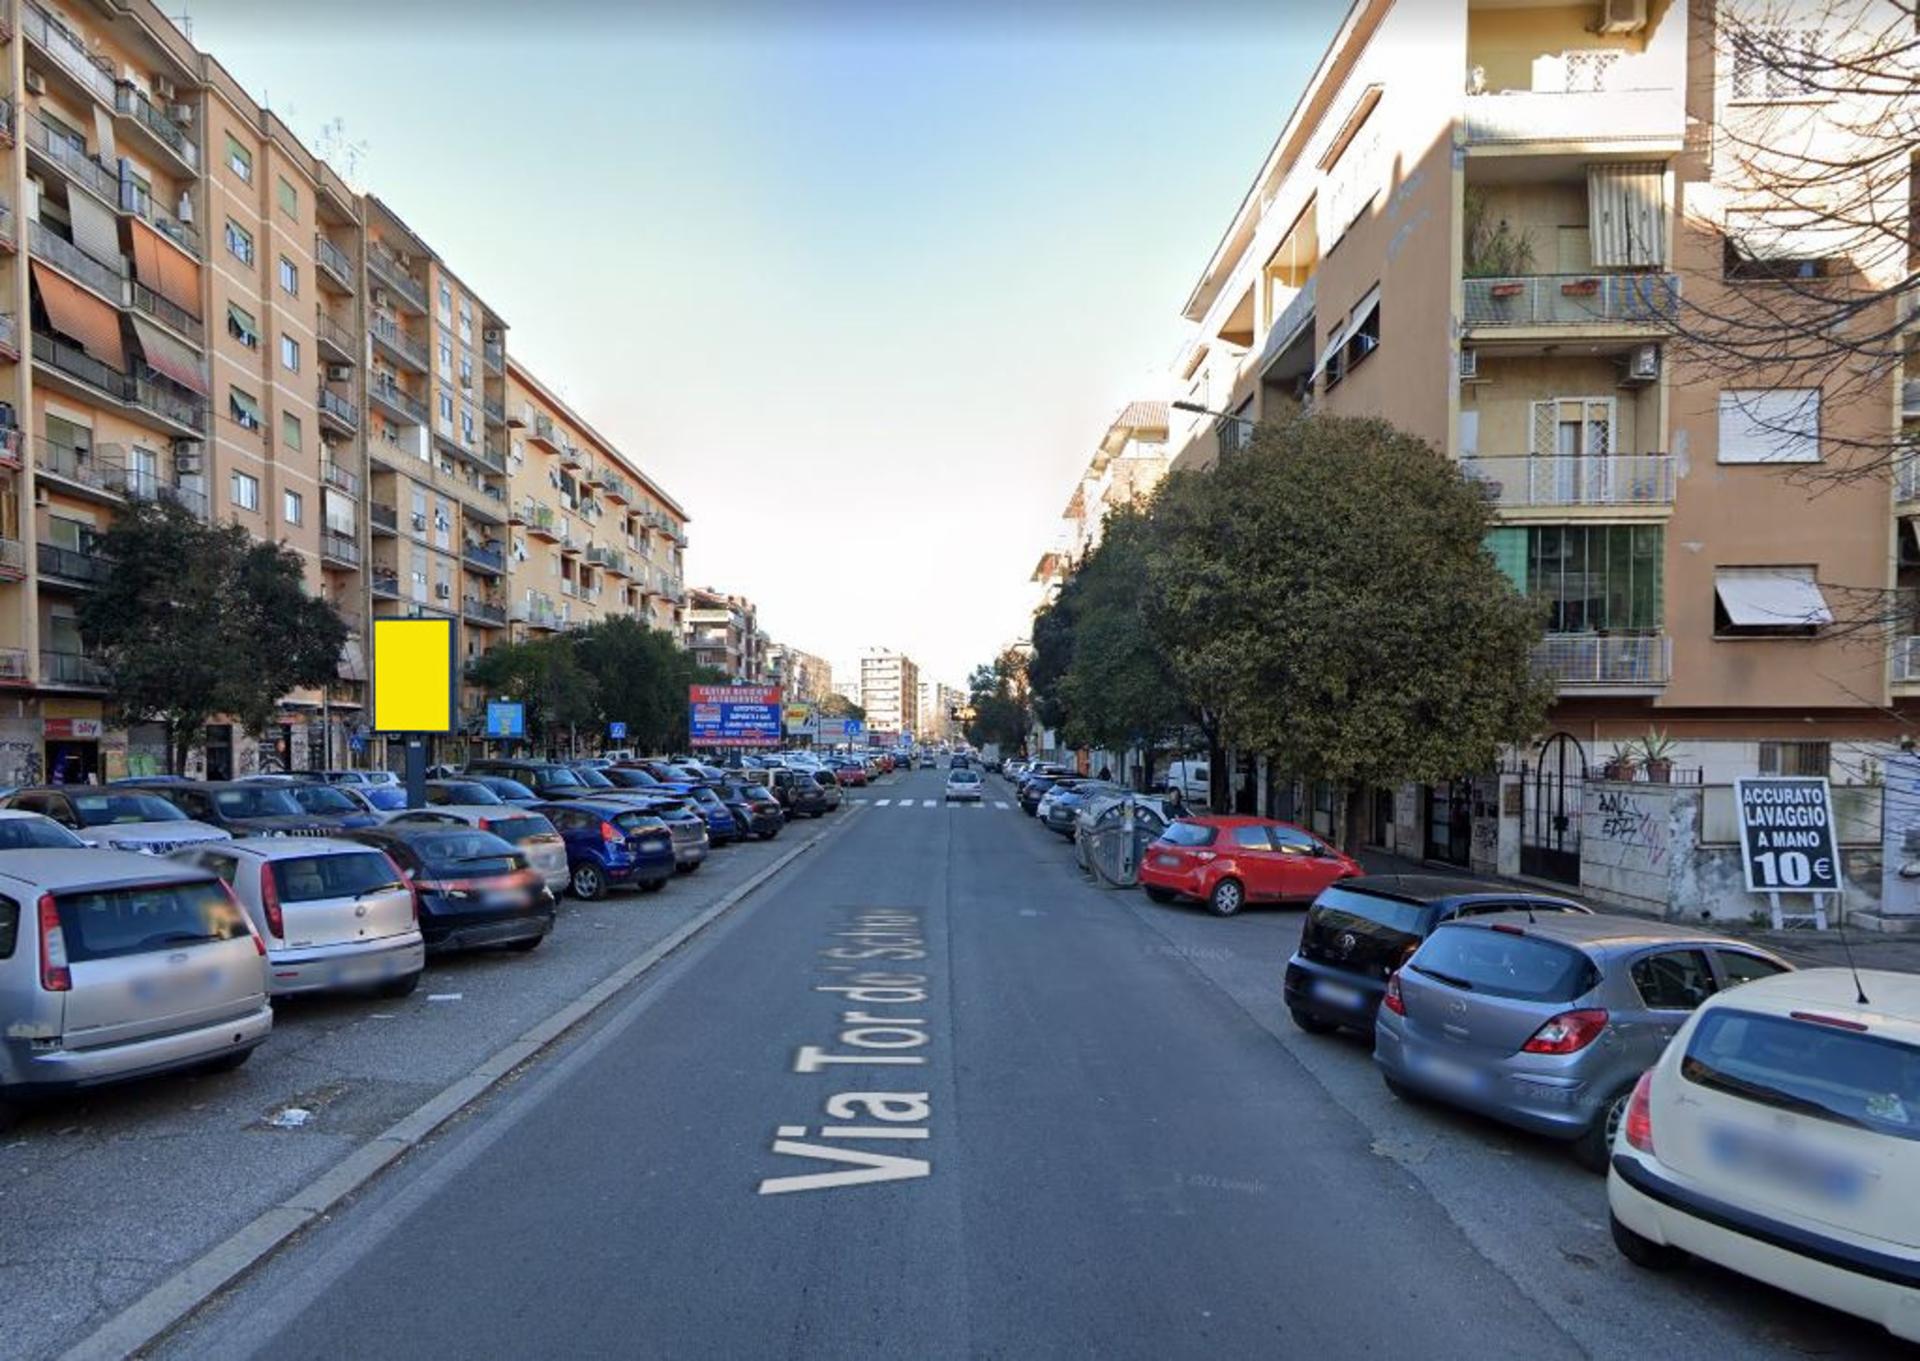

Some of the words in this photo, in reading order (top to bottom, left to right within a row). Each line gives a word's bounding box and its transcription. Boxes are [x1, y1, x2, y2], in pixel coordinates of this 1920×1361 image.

[1743, 788, 1823, 804] ACCURATO
[1745, 806, 1826, 827] LAVAGGIO
[1758, 831, 1770, 847] A
[1771, 831, 1820, 847] MANO
